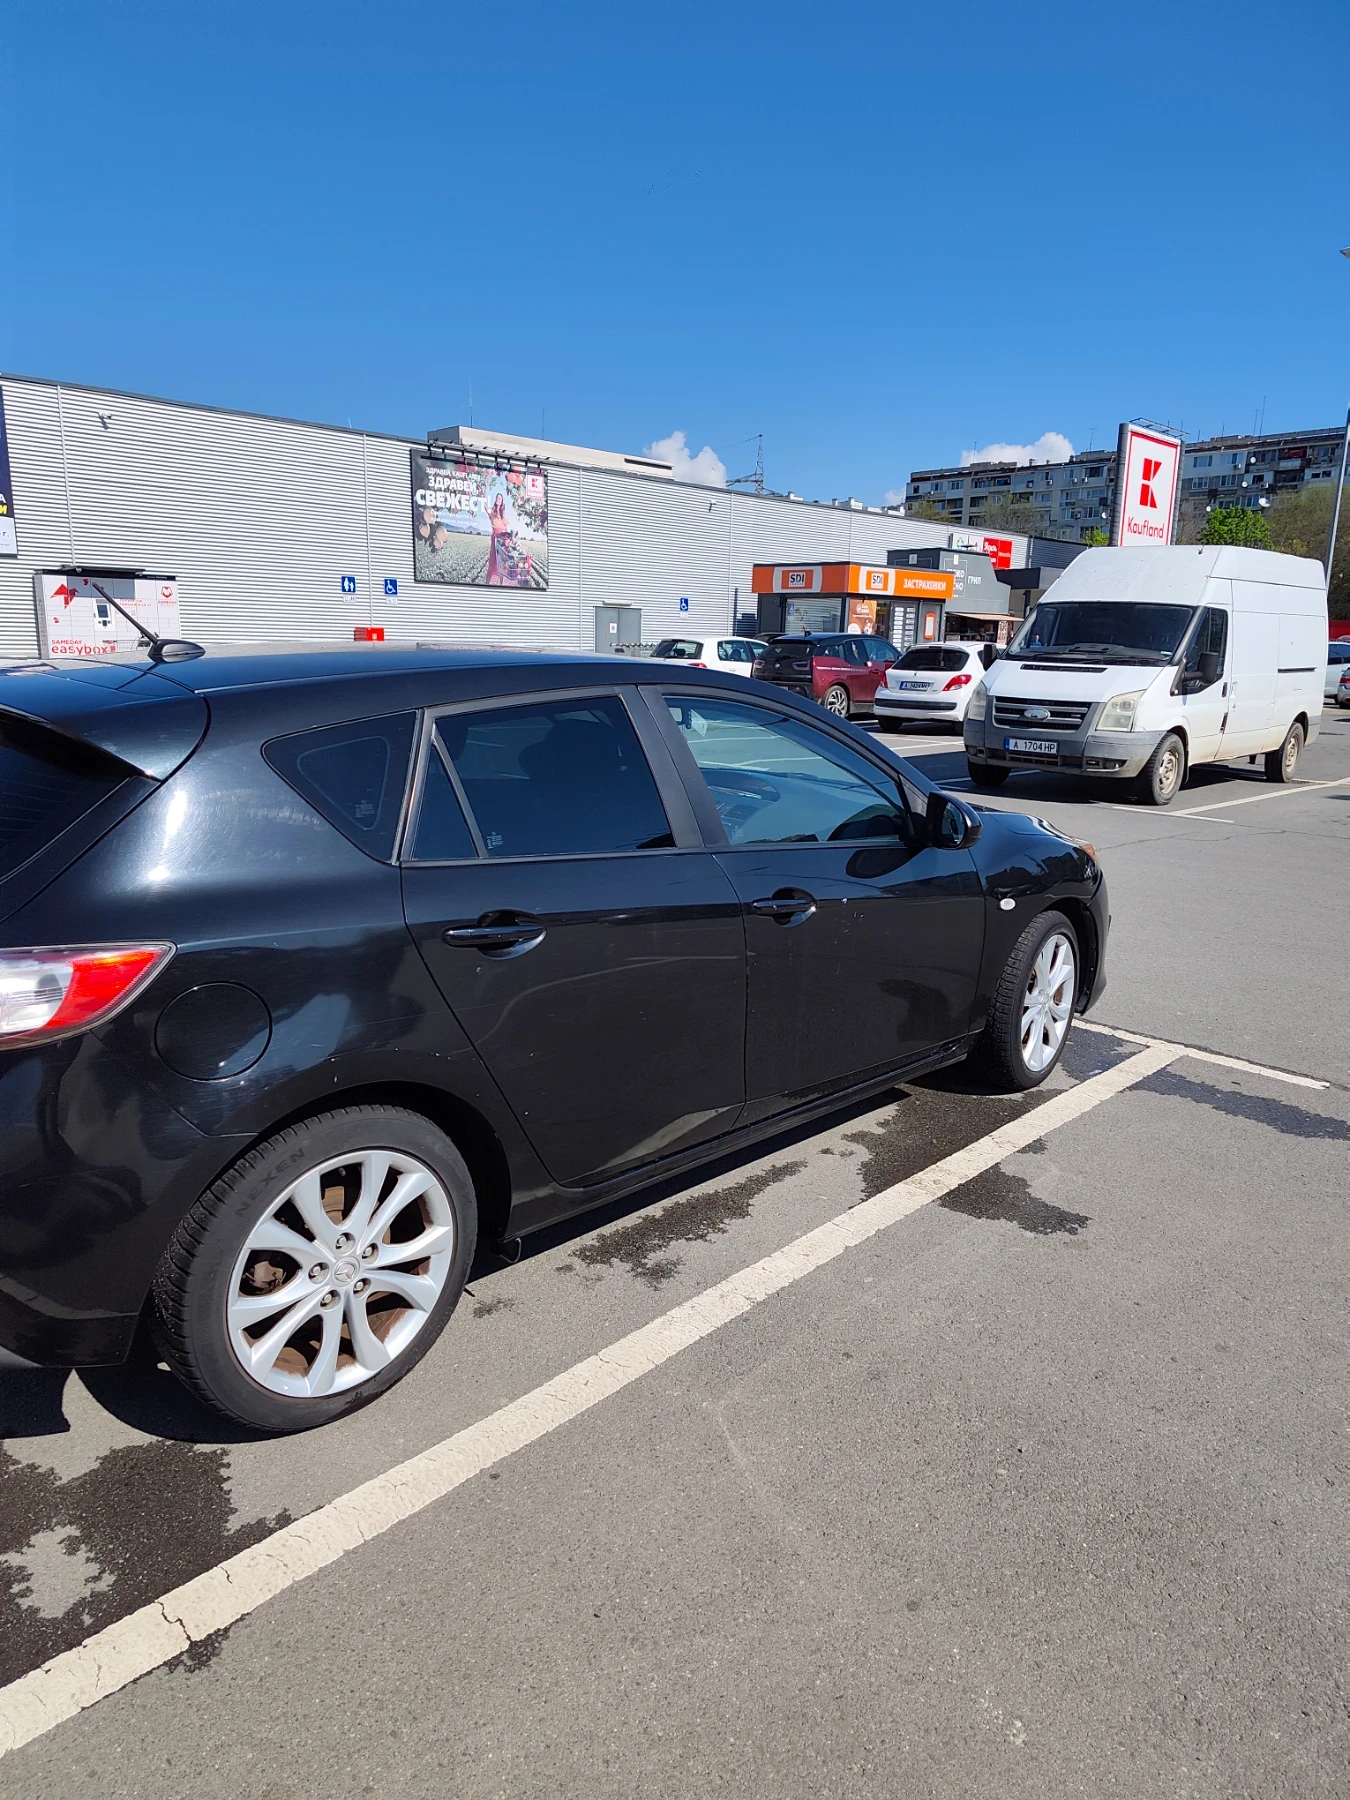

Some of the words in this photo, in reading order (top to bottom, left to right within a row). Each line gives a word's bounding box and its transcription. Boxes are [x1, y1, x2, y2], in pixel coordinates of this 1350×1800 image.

[416, 488, 492, 513] СВЕЖЕСТ!
[1127, 516, 1165, 539] Kaufland
[790, 573, 805, 583] SDI
[872, 574, 883, 585] SDI
[903, 578, 947, 591] ЗАСТРАХОВКИ
[51, 645, 107, 656] easybox
[1024, 741, 1043, 751] 1704
[235, 1147, 306, 1218] NEXEN
